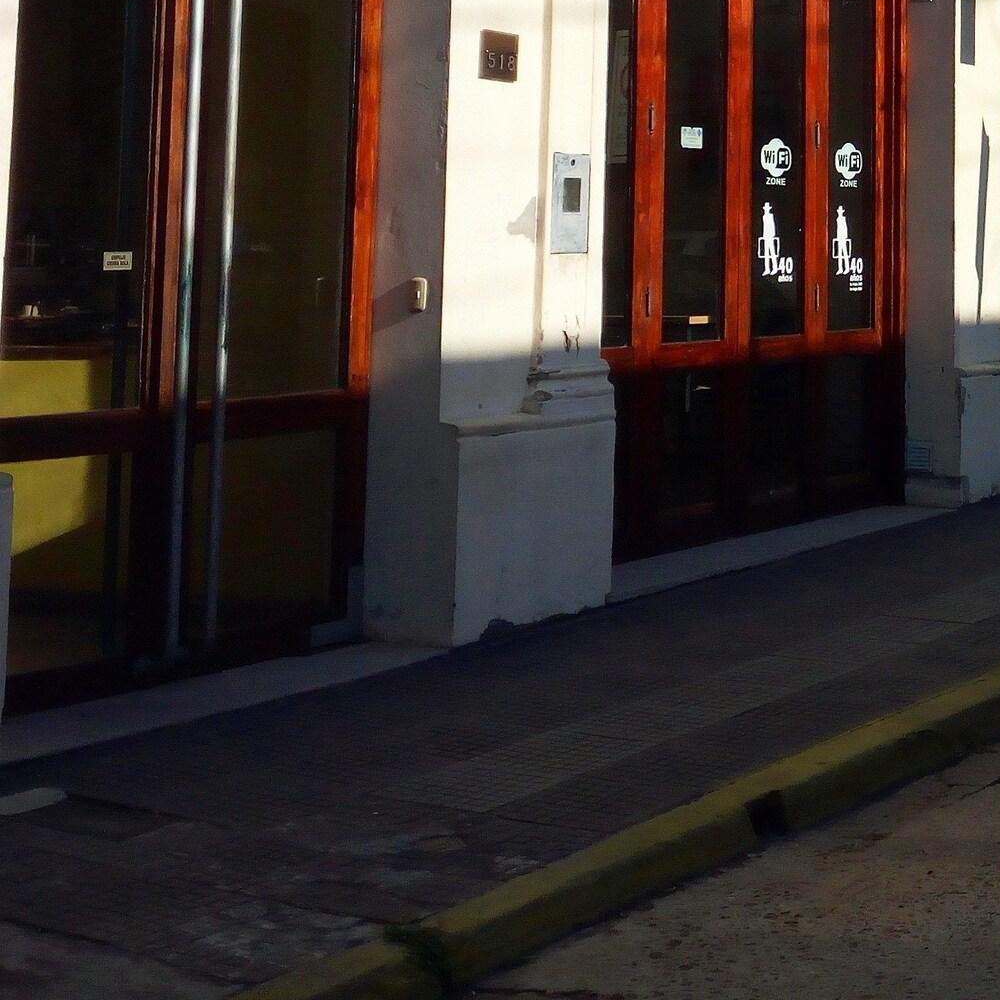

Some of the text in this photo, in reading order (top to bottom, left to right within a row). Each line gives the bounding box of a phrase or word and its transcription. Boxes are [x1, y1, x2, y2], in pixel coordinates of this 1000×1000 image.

[488, 52, 515, 71] 518
[765, 177, 787, 186] ZONE
[839, 180, 858, 188] ZONE
[778, 257, 794, 274] 40
[849, 257, 864, 274] 40
